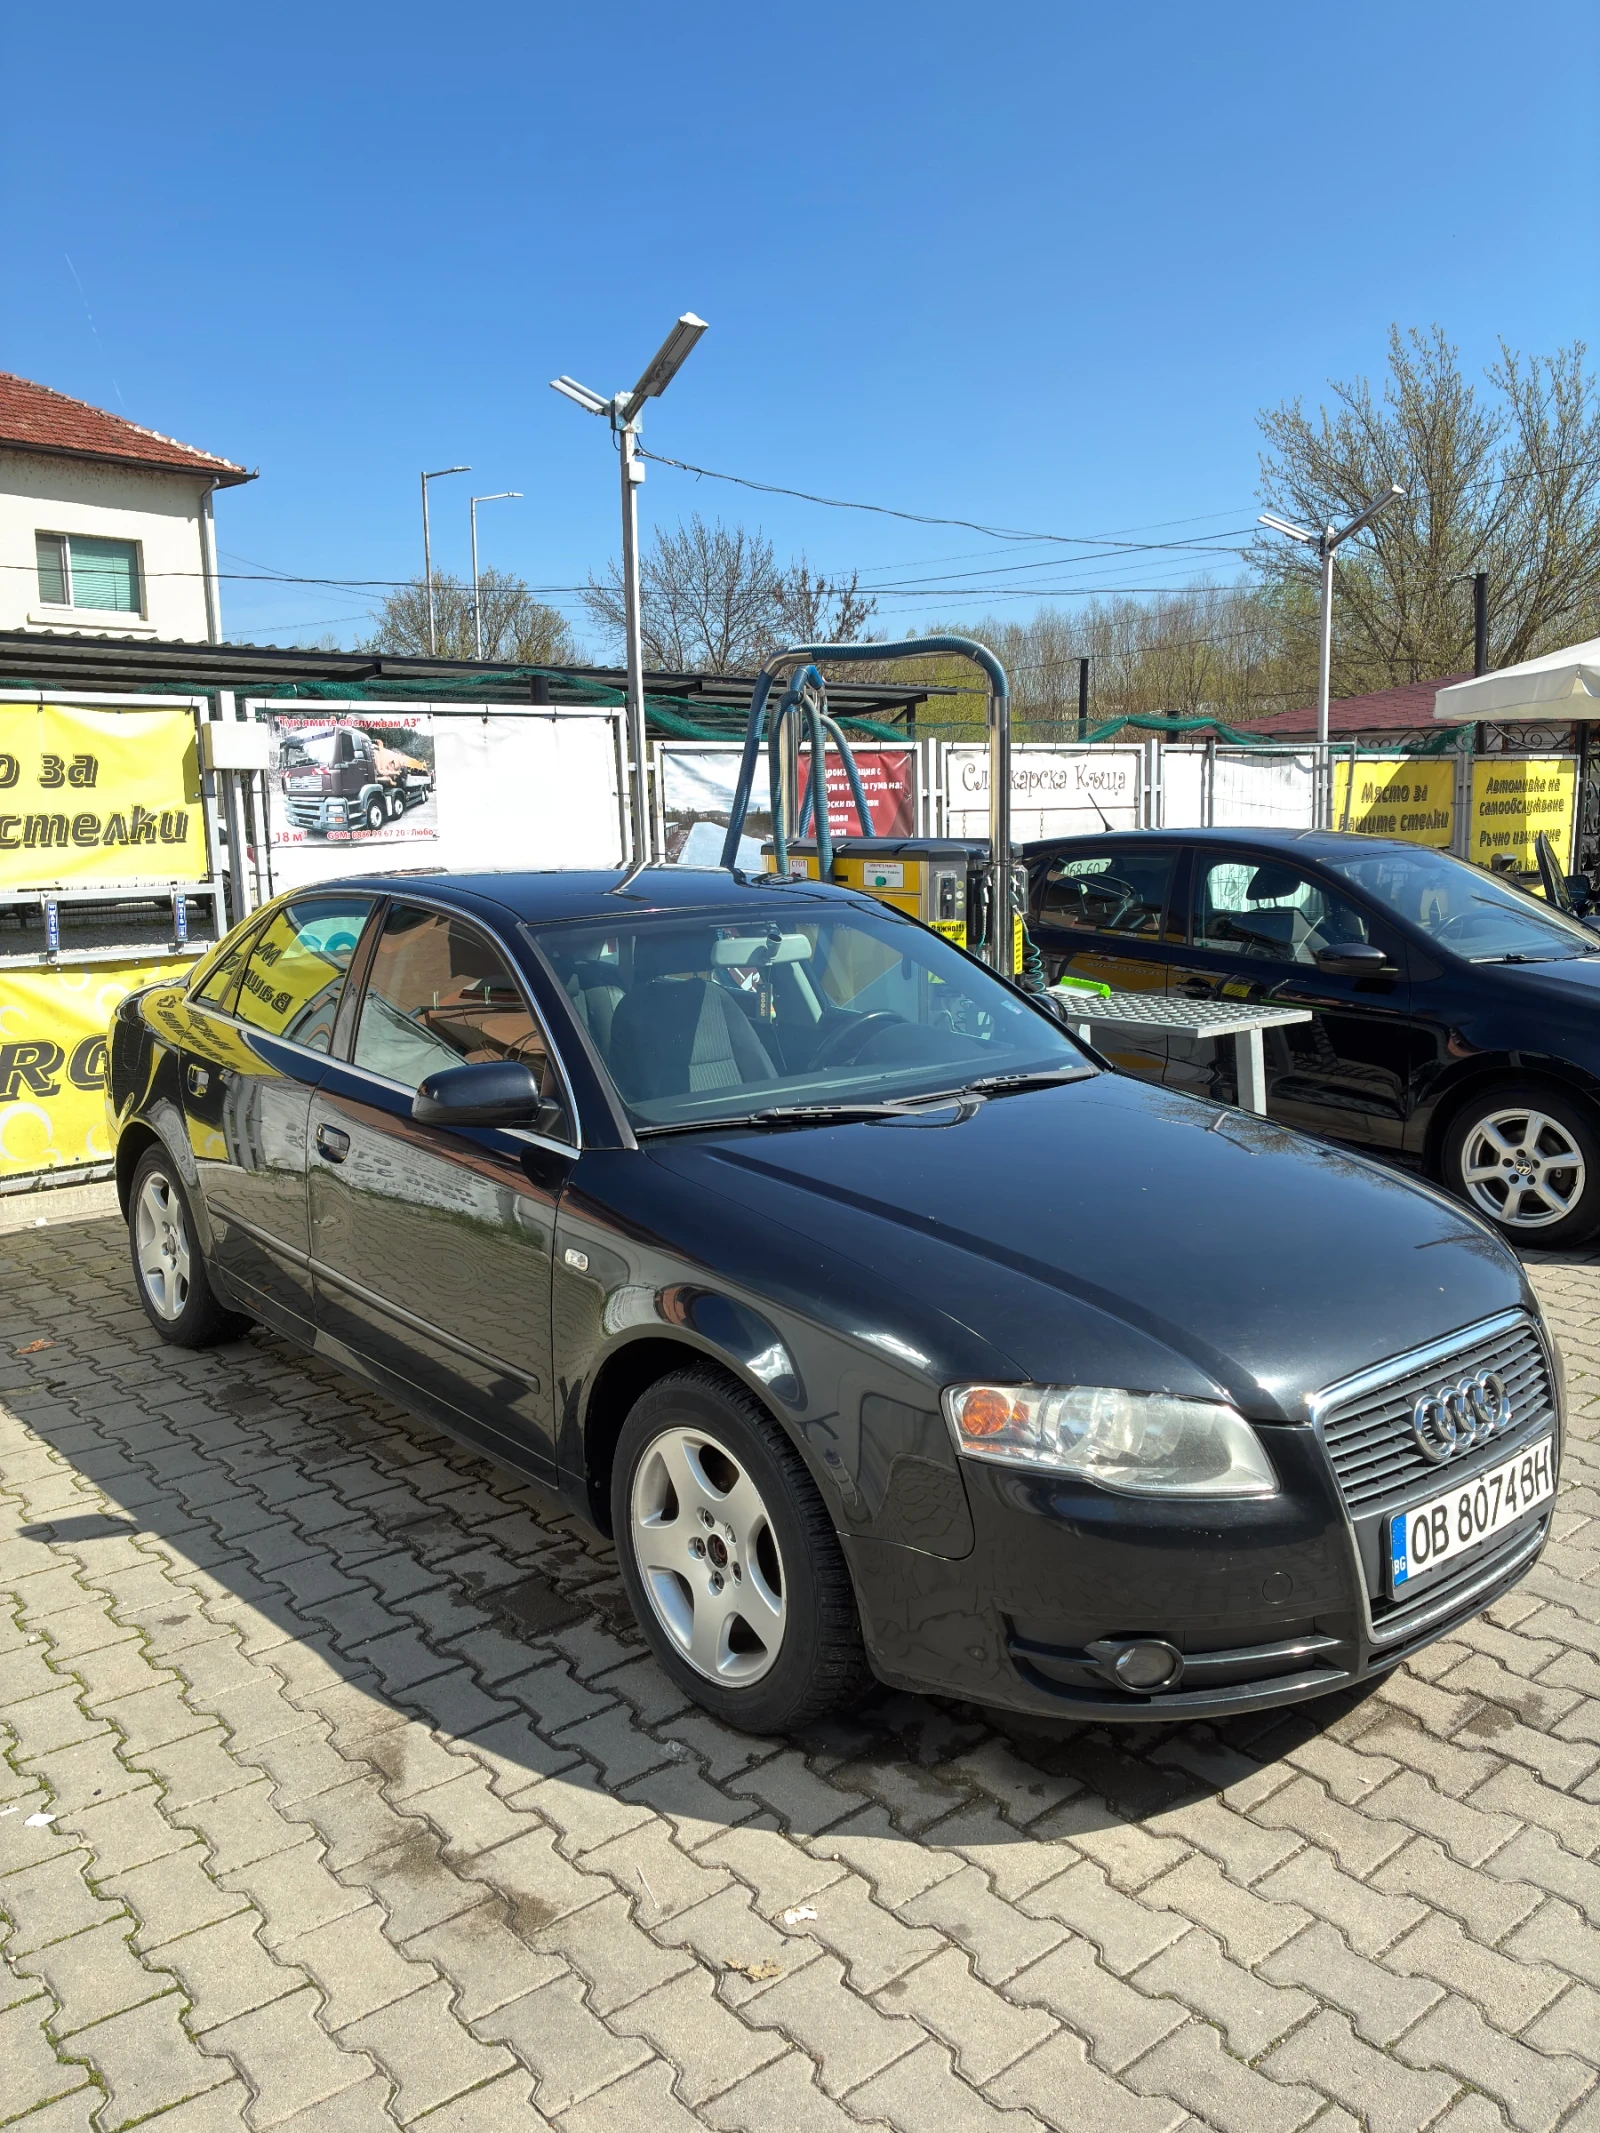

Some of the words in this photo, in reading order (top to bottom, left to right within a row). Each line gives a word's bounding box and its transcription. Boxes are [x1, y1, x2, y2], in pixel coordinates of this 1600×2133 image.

[37, 752, 98, 788] за
[962, 763, 1067, 797] Слкарска
[1074, 764, 1126, 796] Къща
[869, 782, 887, 792] гума
[888, 781, 903, 790] на:
[1361, 781, 1410, 803] Място
[1413, 784, 1428, 802] за
[1485, 775, 1546, 795] Автомивка
[1548, 777, 1560, 792] на
[1479, 797, 1564, 816] самообслужване
[0, 804, 189, 850] стелки
[1400, 808, 1450, 831] стелки
[1480, 830, 1511, 848] Ръчно
[1411, 1504, 1449, 1565] OB
[1393, 1555, 1407, 1575] BG
